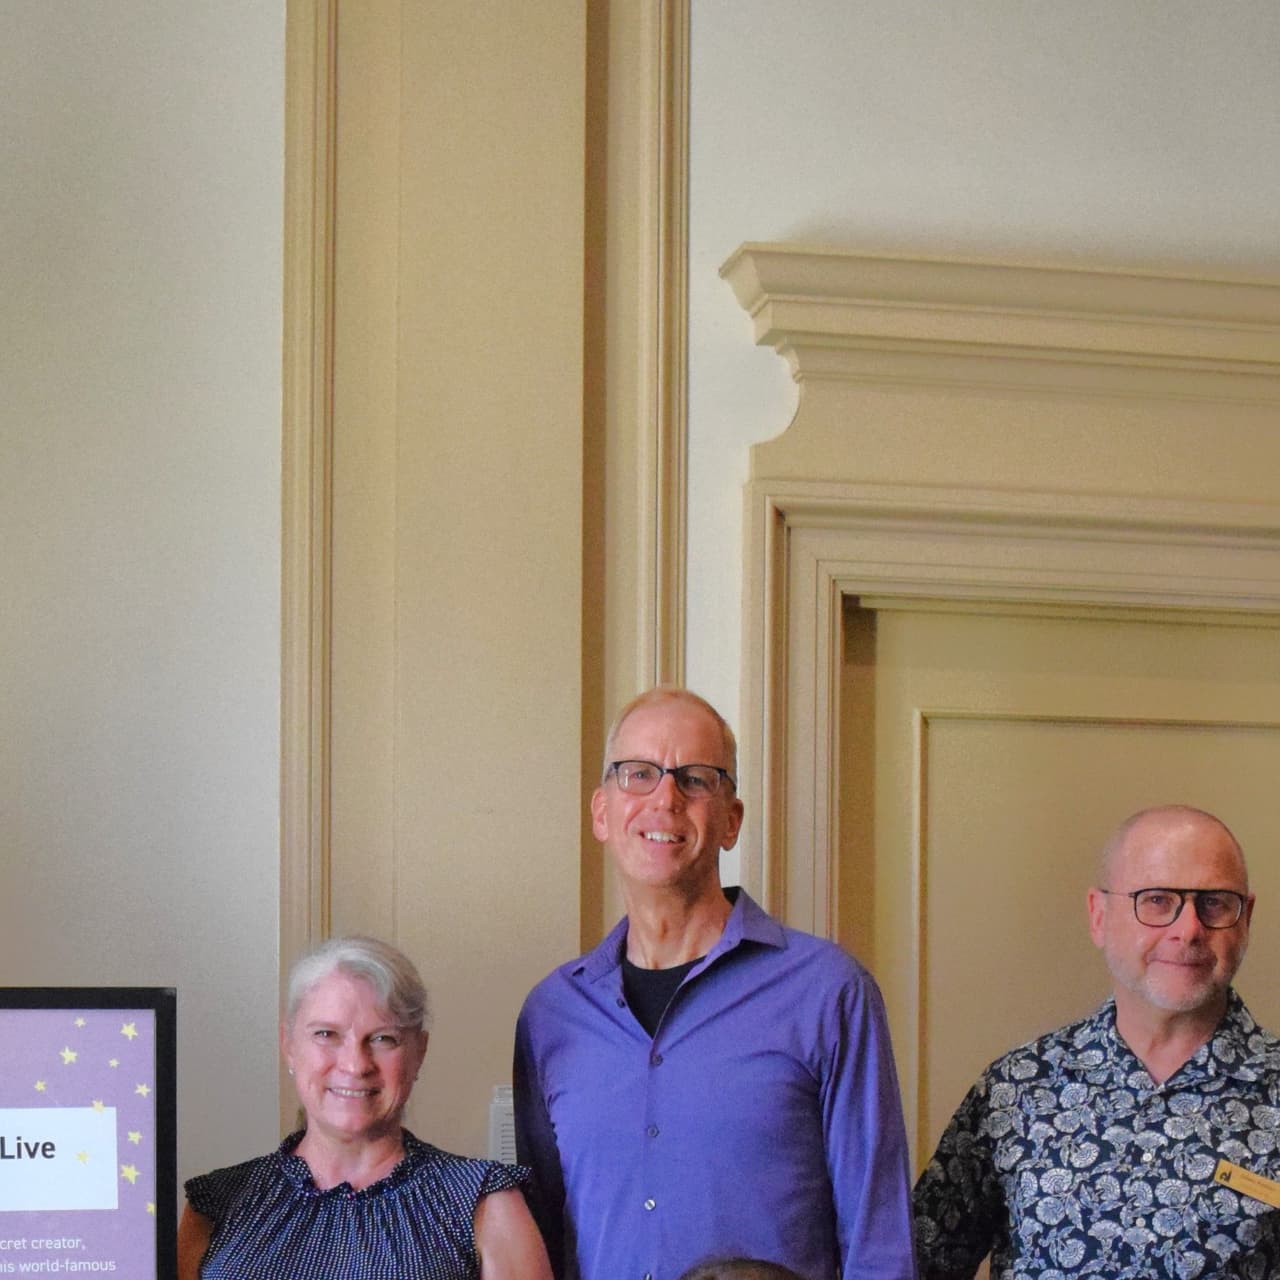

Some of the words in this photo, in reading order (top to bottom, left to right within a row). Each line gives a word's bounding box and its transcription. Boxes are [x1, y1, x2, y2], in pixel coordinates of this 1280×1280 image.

[0, 1135, 56, 1160] Live
[31, 1236, 87, 1251] creator,
[19, 1257, 117, 1273] world-famous
